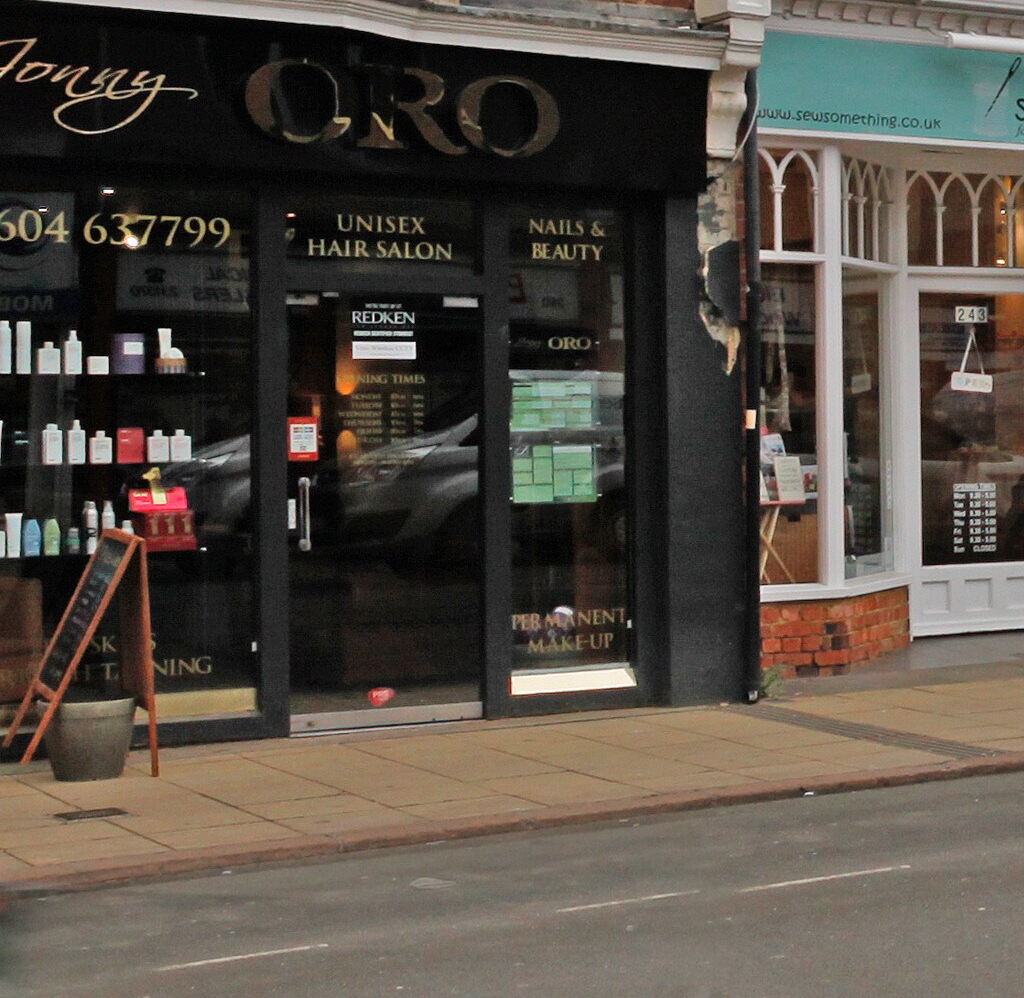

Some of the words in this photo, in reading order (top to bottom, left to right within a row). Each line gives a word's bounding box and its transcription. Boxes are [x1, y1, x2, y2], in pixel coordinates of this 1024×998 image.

[243, 57, 562, 158] ORO
[757, 108, 942, 130] www.sewsomething.co.uk
[83, 213, 231, 248] 637799
[337, 214, 426, 235] UNISEX
[529, 218, 584, 236] NAILS
[590, 221, 606, 237] &
[307, 238, 370, 257] HAIR
[376, 241, 452, 260] SALON
[532, 242, 604, 261] BEAUTY
[352, 310, 416, 324] REDKEN
[958, 307, 986, 321] 243
[548, 337, 592, 350] ORO
[391, 373, 426, 384] TIMES
[511, 608, 625, 630] PERMANENT
[528, 632, 614, 654] MAKE-UP
